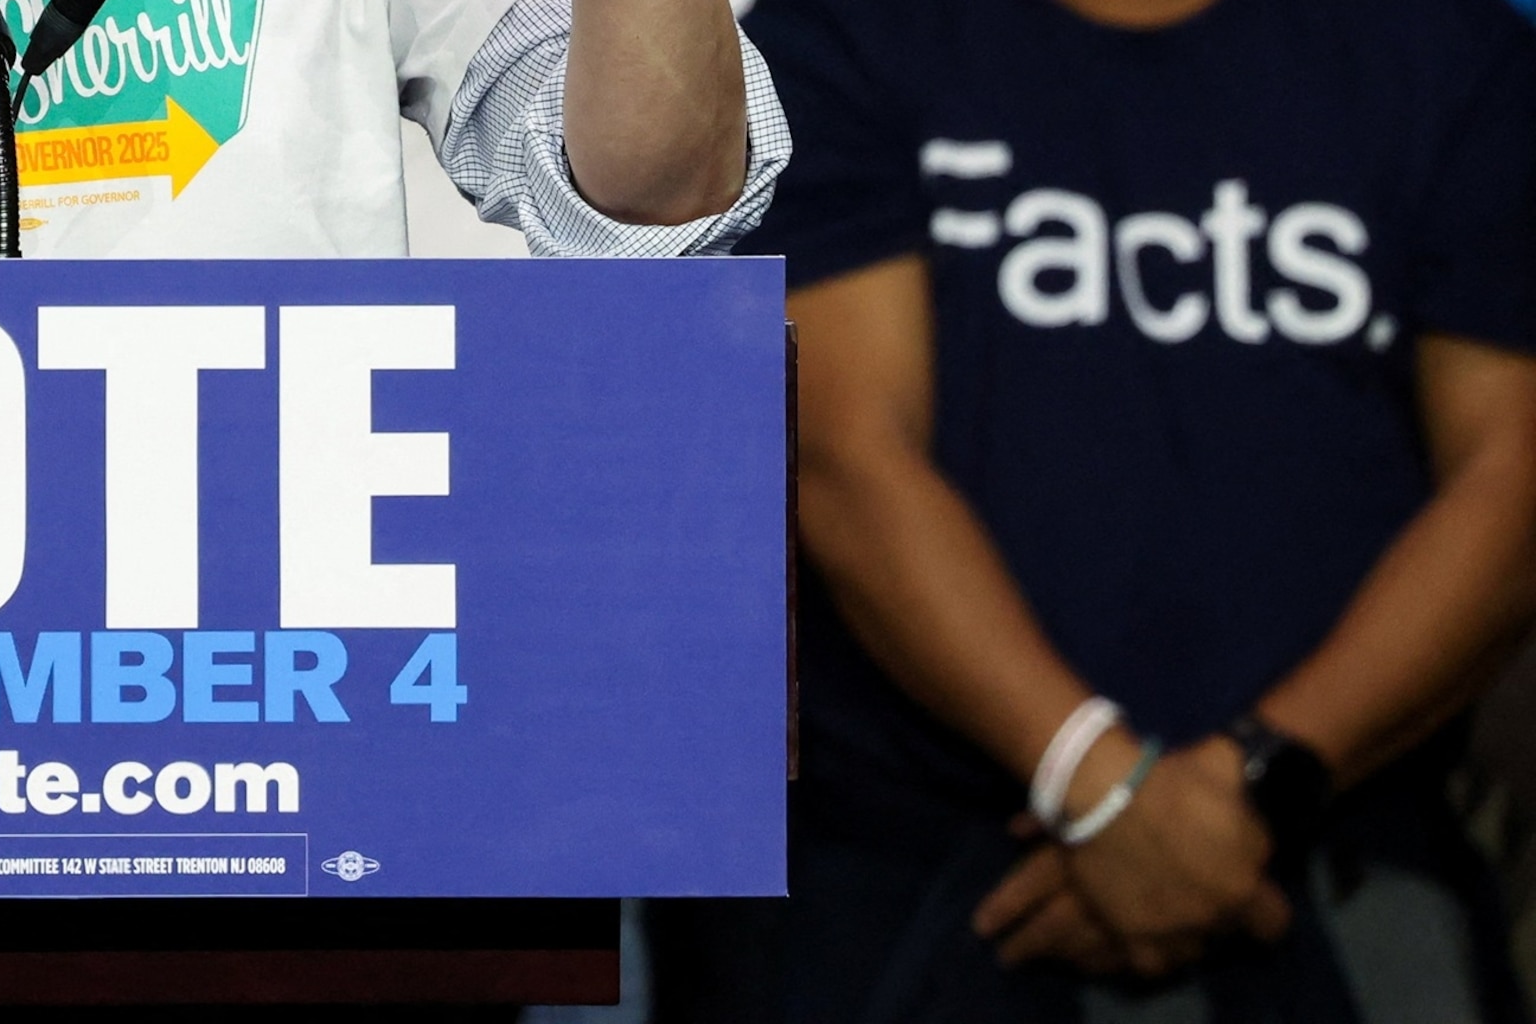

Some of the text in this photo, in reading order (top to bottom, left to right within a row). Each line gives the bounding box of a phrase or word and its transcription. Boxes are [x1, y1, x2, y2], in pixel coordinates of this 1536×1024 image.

[117, 131, 170, 165] 2025
[58, 195, 79, 208] FOR
[81, 189, 141, 206] GOVERNOR
[390, 632, 467, 724] 4
[60, 857, 83, 875] 142
[82, 857, 98, 875] W
[97, 857, 133, 875] STATE
[132, 857, 173, 875] STREET
[175, 857, 228, 874] TRENTON
[229, 857, 246, 874] NJ
[246, 857, 287, 874] 08608
